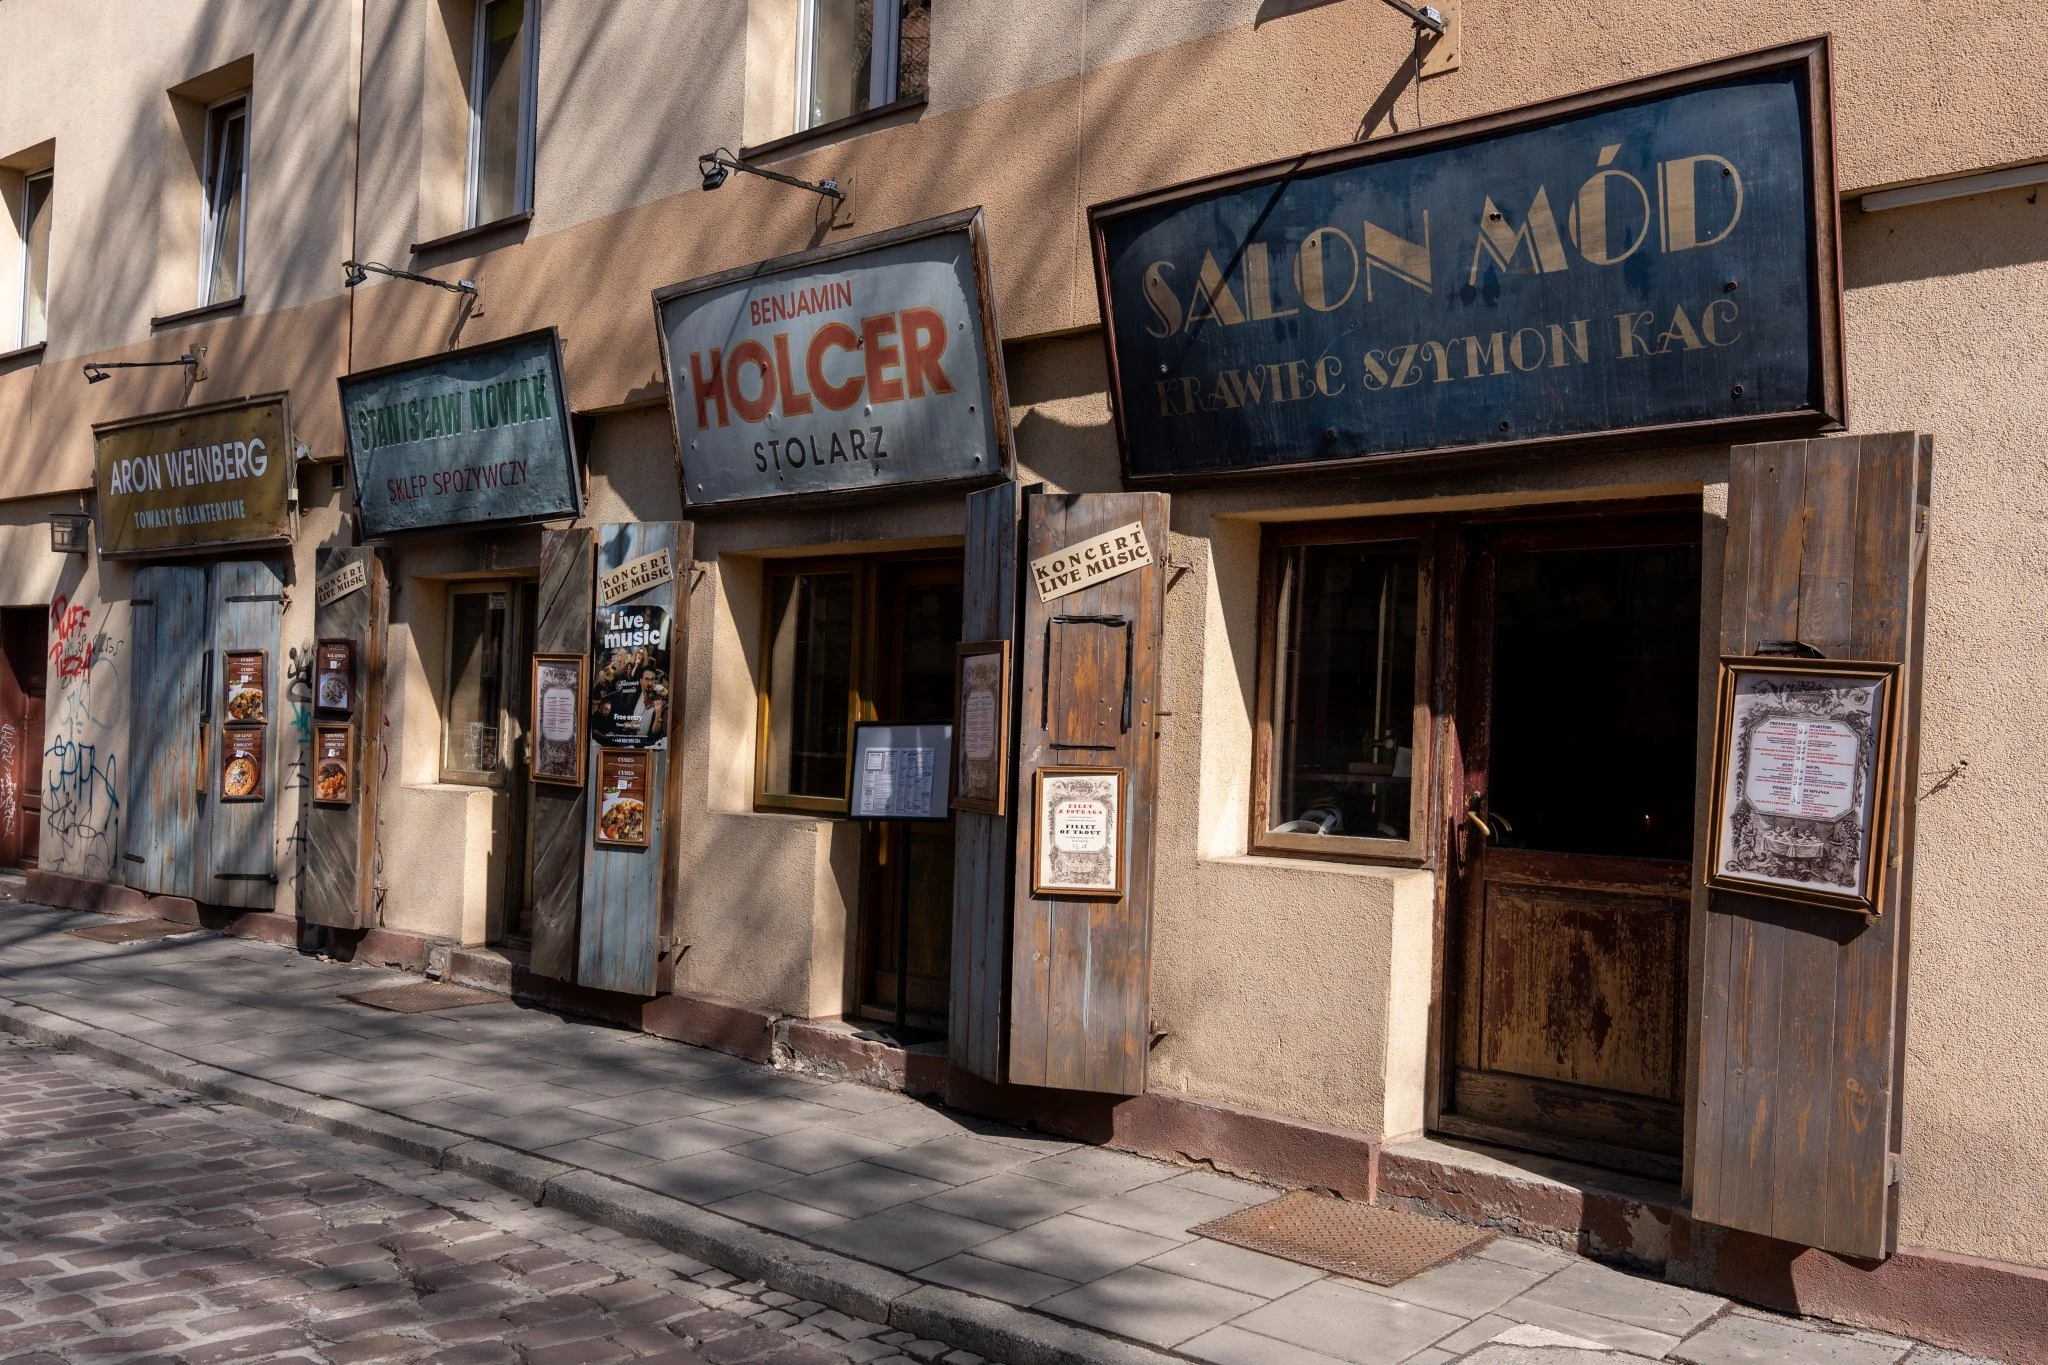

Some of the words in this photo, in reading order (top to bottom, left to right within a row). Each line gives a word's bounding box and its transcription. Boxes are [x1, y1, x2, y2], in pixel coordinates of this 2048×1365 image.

[1142, 209, 1433, 339] SALON
[1469, 143, 1743, 286] MÓD
[750, 280, 852, 326] BENJAMIN
[689, 305, 957, 431] HOLCER
[1154, 356, 1346, 418] KRAWIEC
[1363, 319, 1591, 390] SZYMON
[1613, 299, 1742, 359] KAC
[358, 391, 464, 452] STANISŁAW
[469, 373, 552, 433] NOWAK
[110, 454, 162, 496] ARON
[164, 437, 268, 488] WEINBERG
[753, 425, 888, 472] STOLARZ
[387, 474, 427, 501] SKLEP
[433, 460, 528, 496] SPOŻYWCZY
[134, 508, 173, 529] TOWARY
[175, 500, 246, 525] GALANTERYJNE
[602, 555, 667, 589] KONCERT
[1035, 530, 1141, 580] KONCERT
[1039, 569, 1082, 594] LIVE
[1086, 545, 1147, 577] MUSIC
[317, 565, 362, 594] KONCERT
[319, 588, 336, 602] LIVE
[337, 575, 364, 593] MUSIC
[605, 581, 628, 600] LIVE
[631, 566, 670, 588] MUSIC
[604, 624, 661, 648] music
[610, 611, 644, 630] Live
[627, 714, 643, 722] entry
